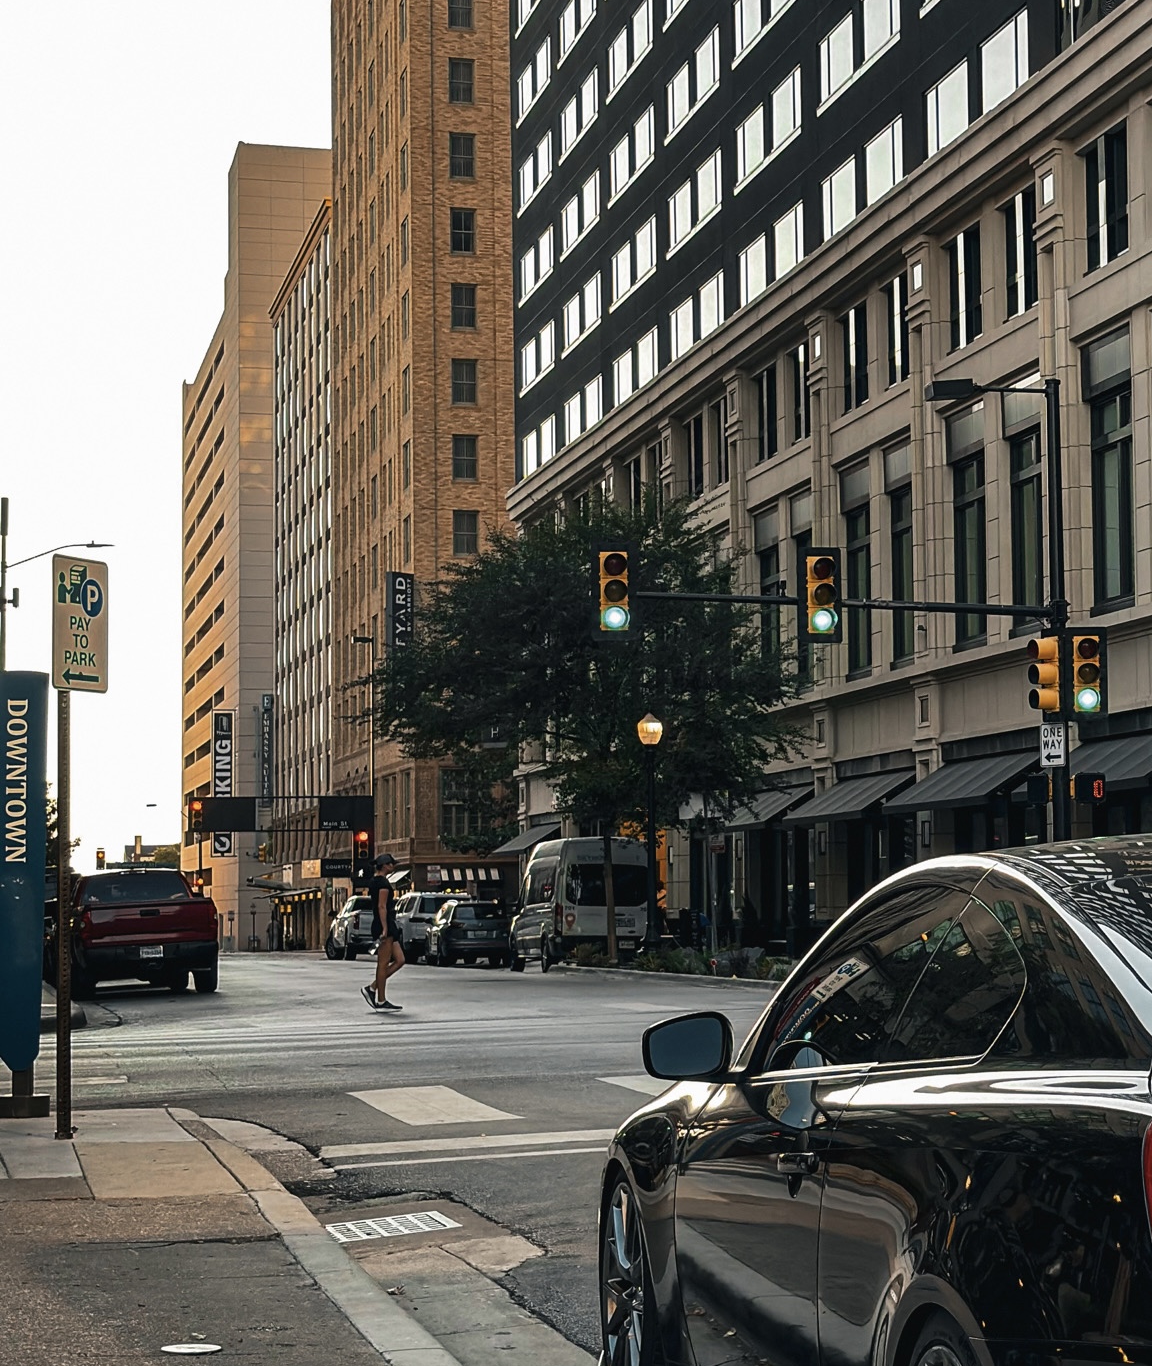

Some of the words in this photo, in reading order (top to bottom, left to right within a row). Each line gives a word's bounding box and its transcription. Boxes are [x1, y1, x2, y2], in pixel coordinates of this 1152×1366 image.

[70, 615, 92, 632] PAY
[72, 633, 89, 649] TO
[64, 650, 97, 668] PARK
[263, 696, 270, 707] E
[1042, 727, 1062, 738] ONE
[1042, 739, 1062, 750] WAY
[215, 739, 232, 797] KING
[5, 698, 29, 864] DOWNTOWN
